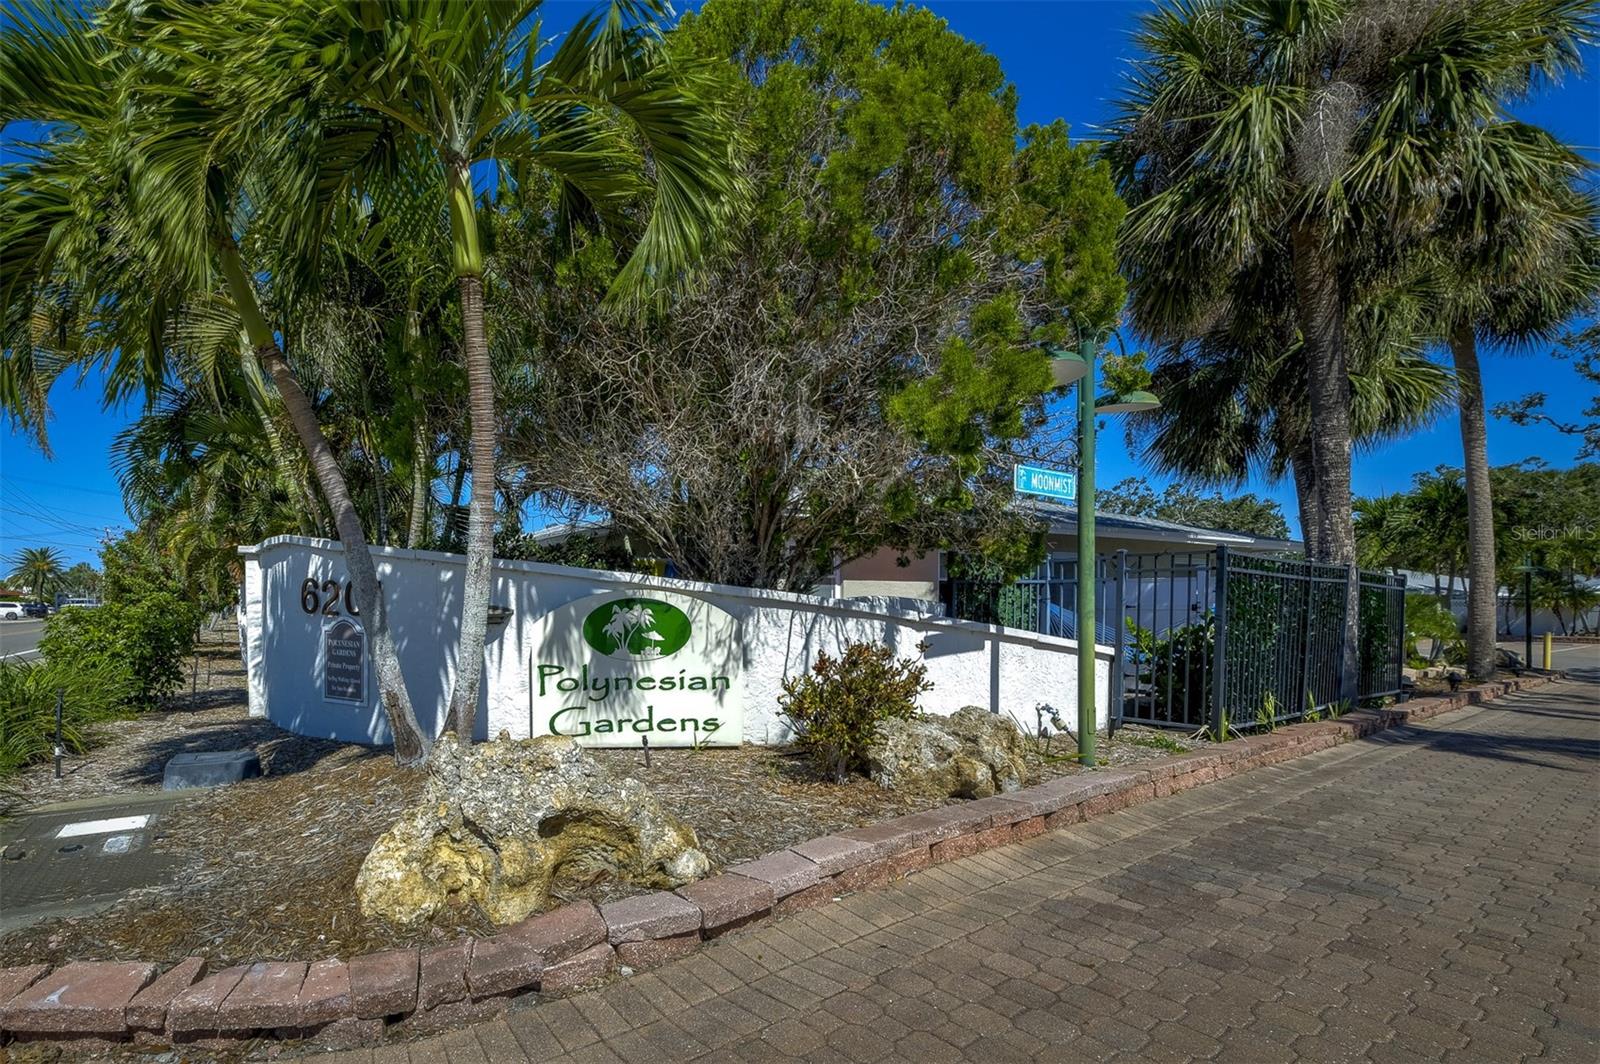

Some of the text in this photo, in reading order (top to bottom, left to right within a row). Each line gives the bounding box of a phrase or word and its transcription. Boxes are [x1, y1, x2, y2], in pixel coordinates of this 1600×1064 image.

[1031, 473, 1072, 494] MOONMIST
[537, 664, 731, 701] Polynesian
[549, 705, 720, 738] Gardens
